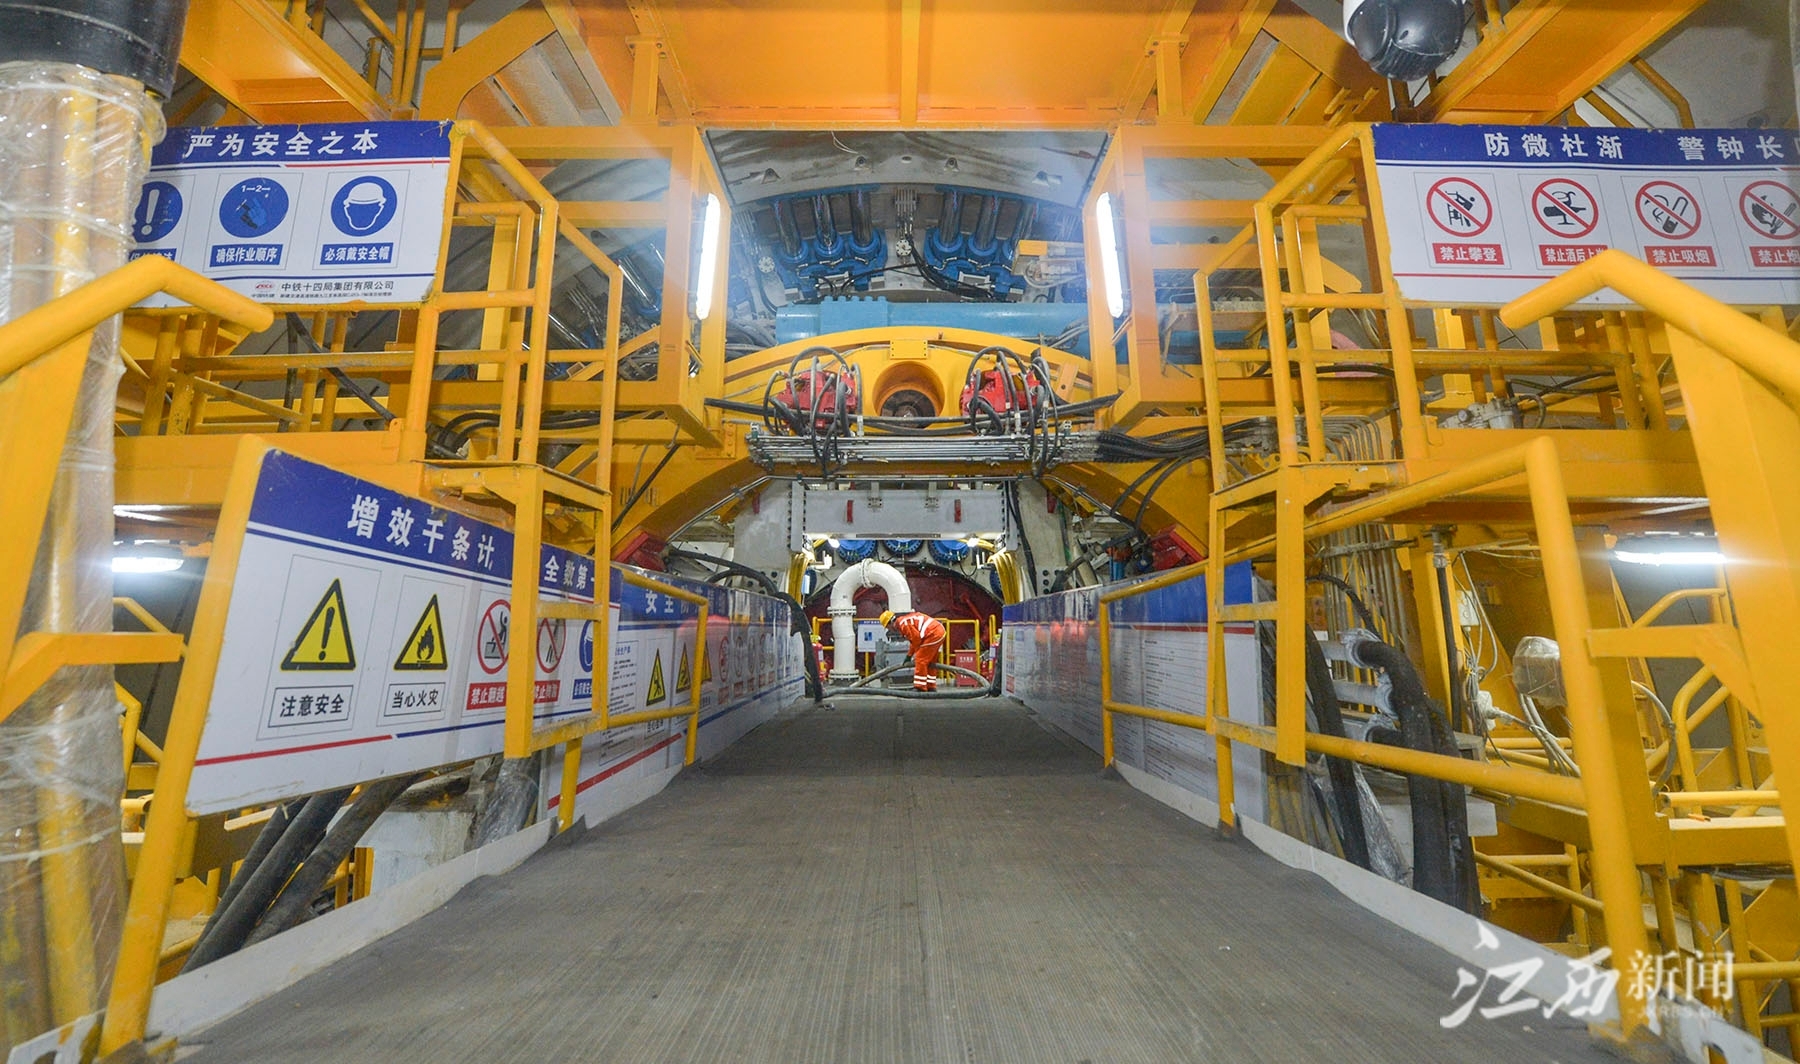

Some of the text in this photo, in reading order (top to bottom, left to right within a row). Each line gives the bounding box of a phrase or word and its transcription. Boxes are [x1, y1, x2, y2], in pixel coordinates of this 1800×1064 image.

[184, 129, 378, 158] 严为安全之本
[1484, 132, 1624, 159] 防微杜渐
[215, 247, 278, 264] 确保作业顺序
[324, 245, 390, 262] 必须戴安全帽
[1439, 246, 1498, 263] 禁止攀登
[1653, 250, 1710, 264] 禁止吸烟
[1759, 250, 1800, 264] 禁止烟
[281, 281, 394, 292] 中铁十四局集团有限公司
[544, 555, 594, 590] 全数第
[279, 693, 344, 718] 注意安全
[393, 689, 439, 709] 当心火灾
